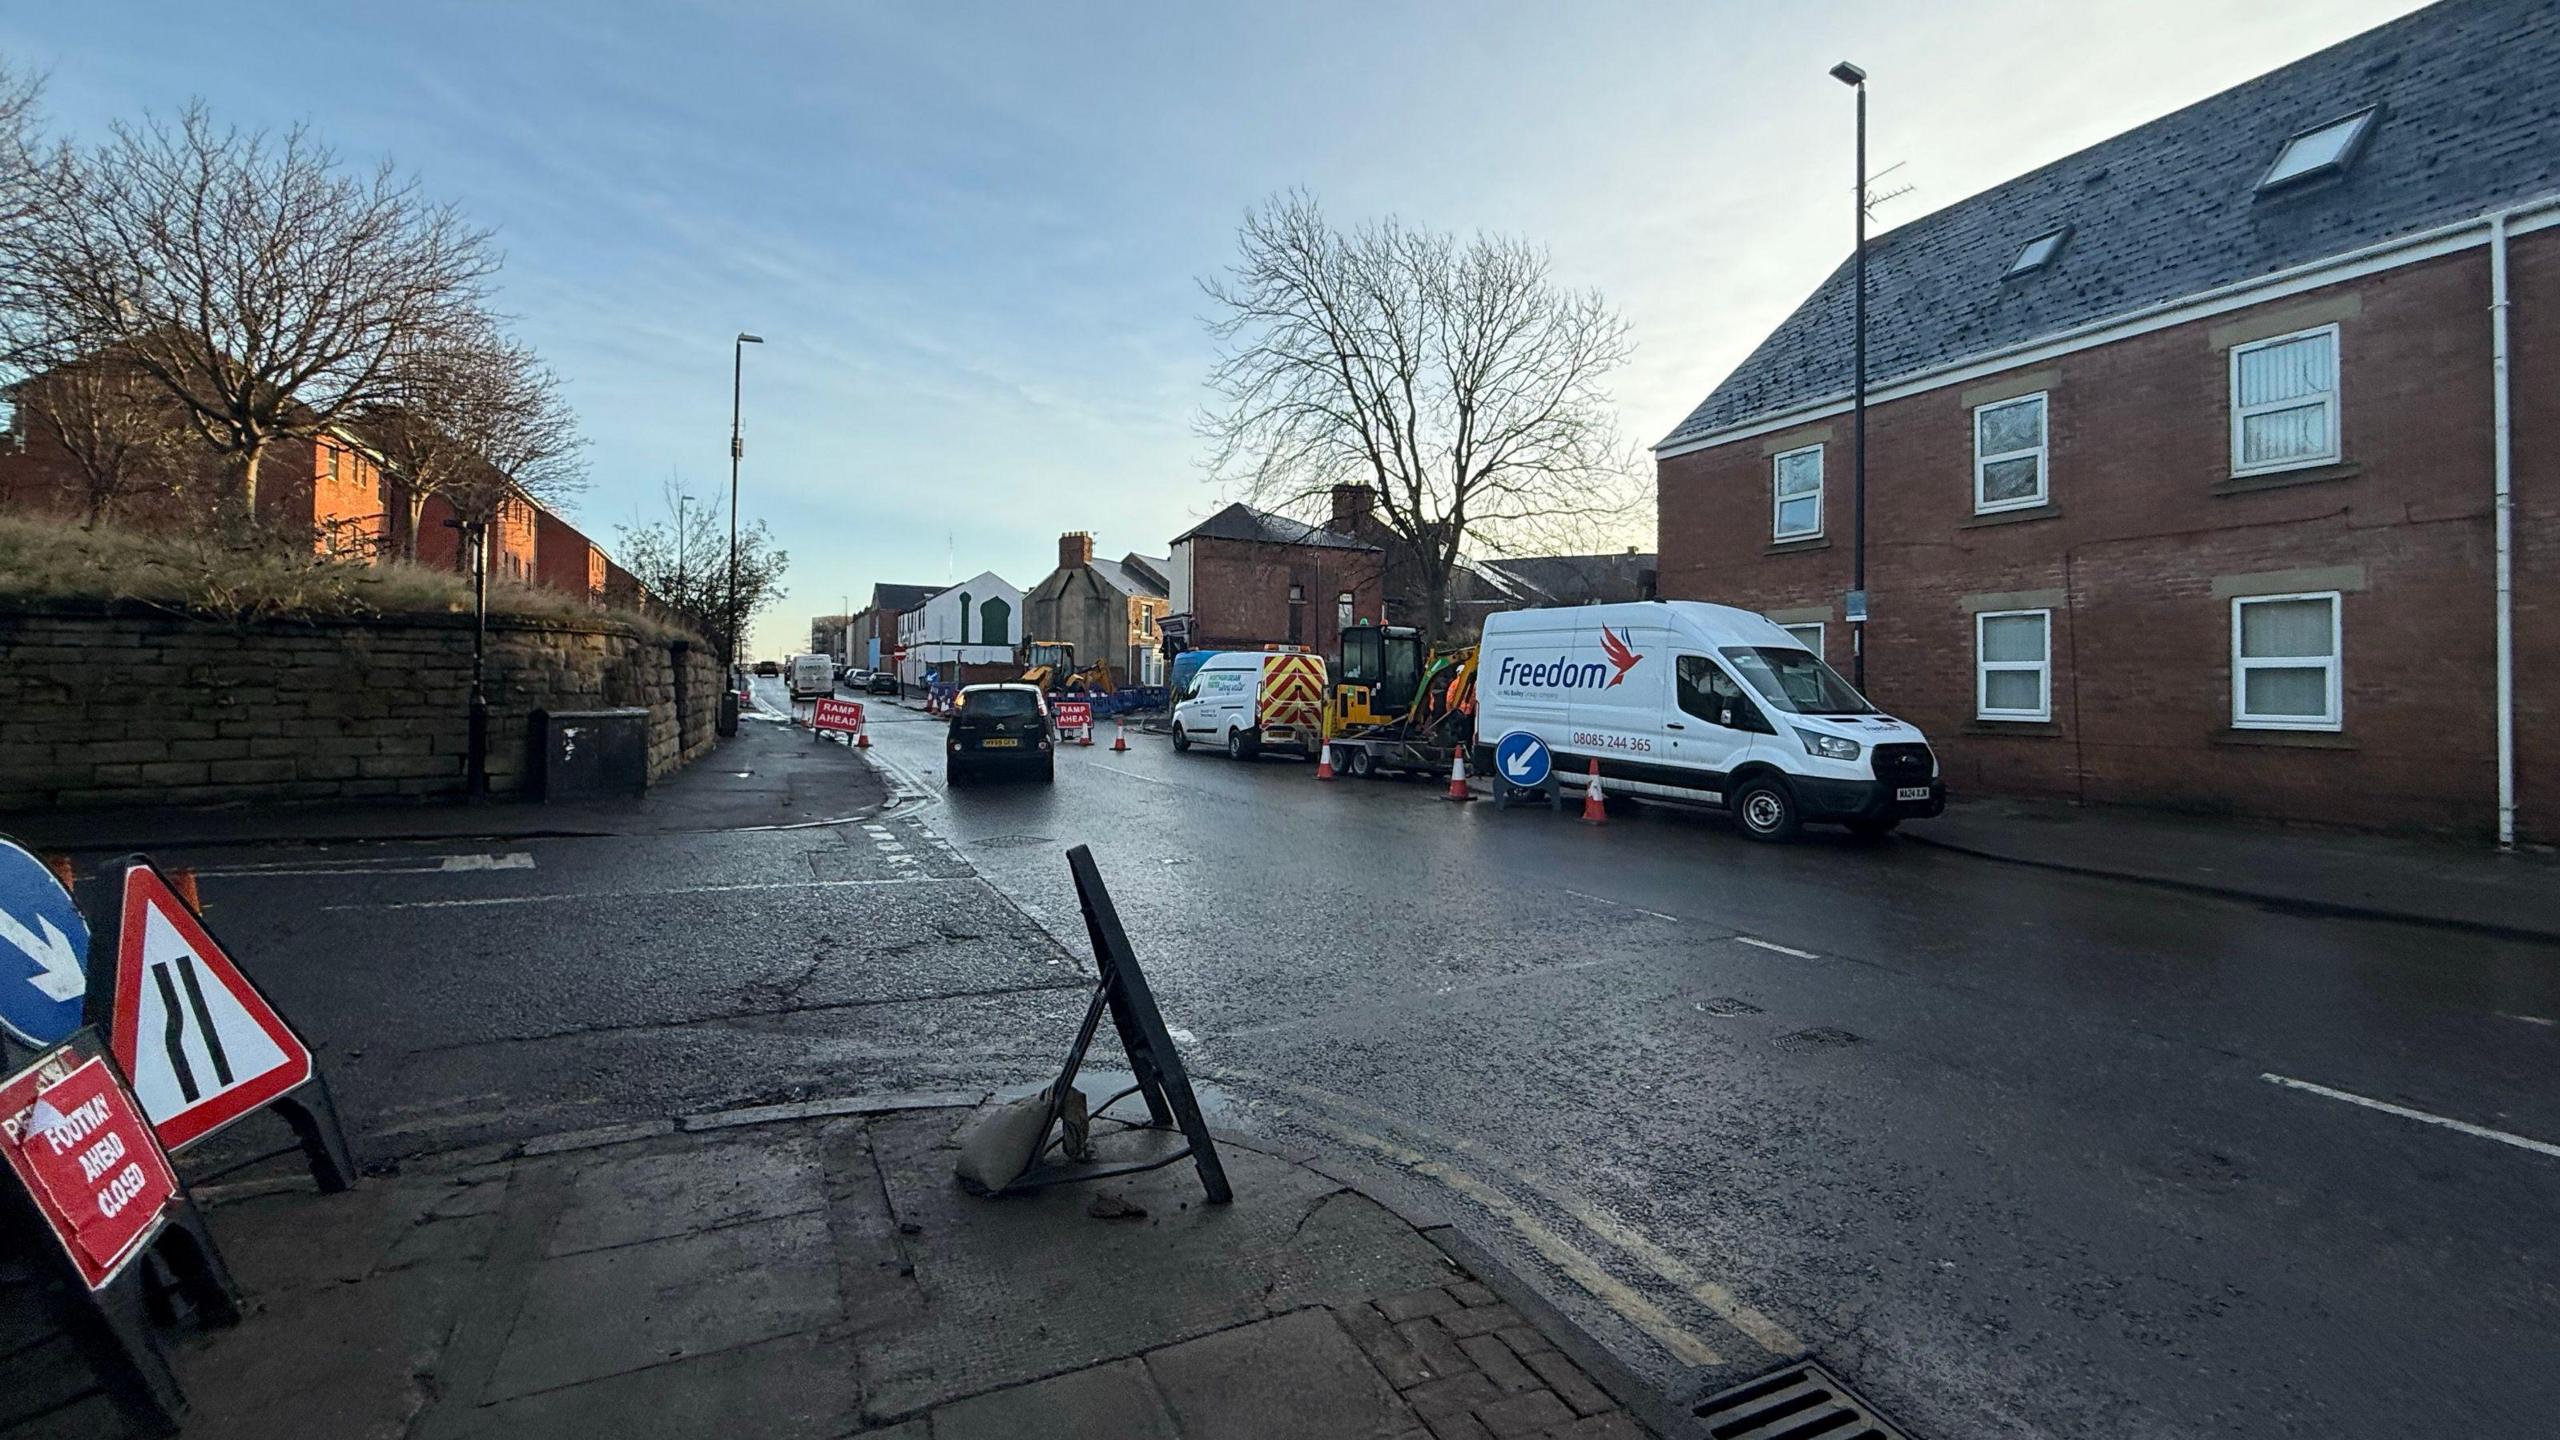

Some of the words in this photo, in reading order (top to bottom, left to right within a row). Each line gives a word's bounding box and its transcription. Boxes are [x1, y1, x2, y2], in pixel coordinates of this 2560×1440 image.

[1498, 655, 1607, 689] Freedom
[818, 713, 857, 726] AHEAD
[823, 703, 855, 715] RAMP
[1573, 732, 1605, 747] 08085
[1607, 735, 1627, 749] 244
[1630, 737, 1651, 752] 365
[44, 1092, 113, 1156] FOOTWAY
[78, 1131, 126, 1184] AHEAD
[97, 1162, 146, 1219] CLOSED
